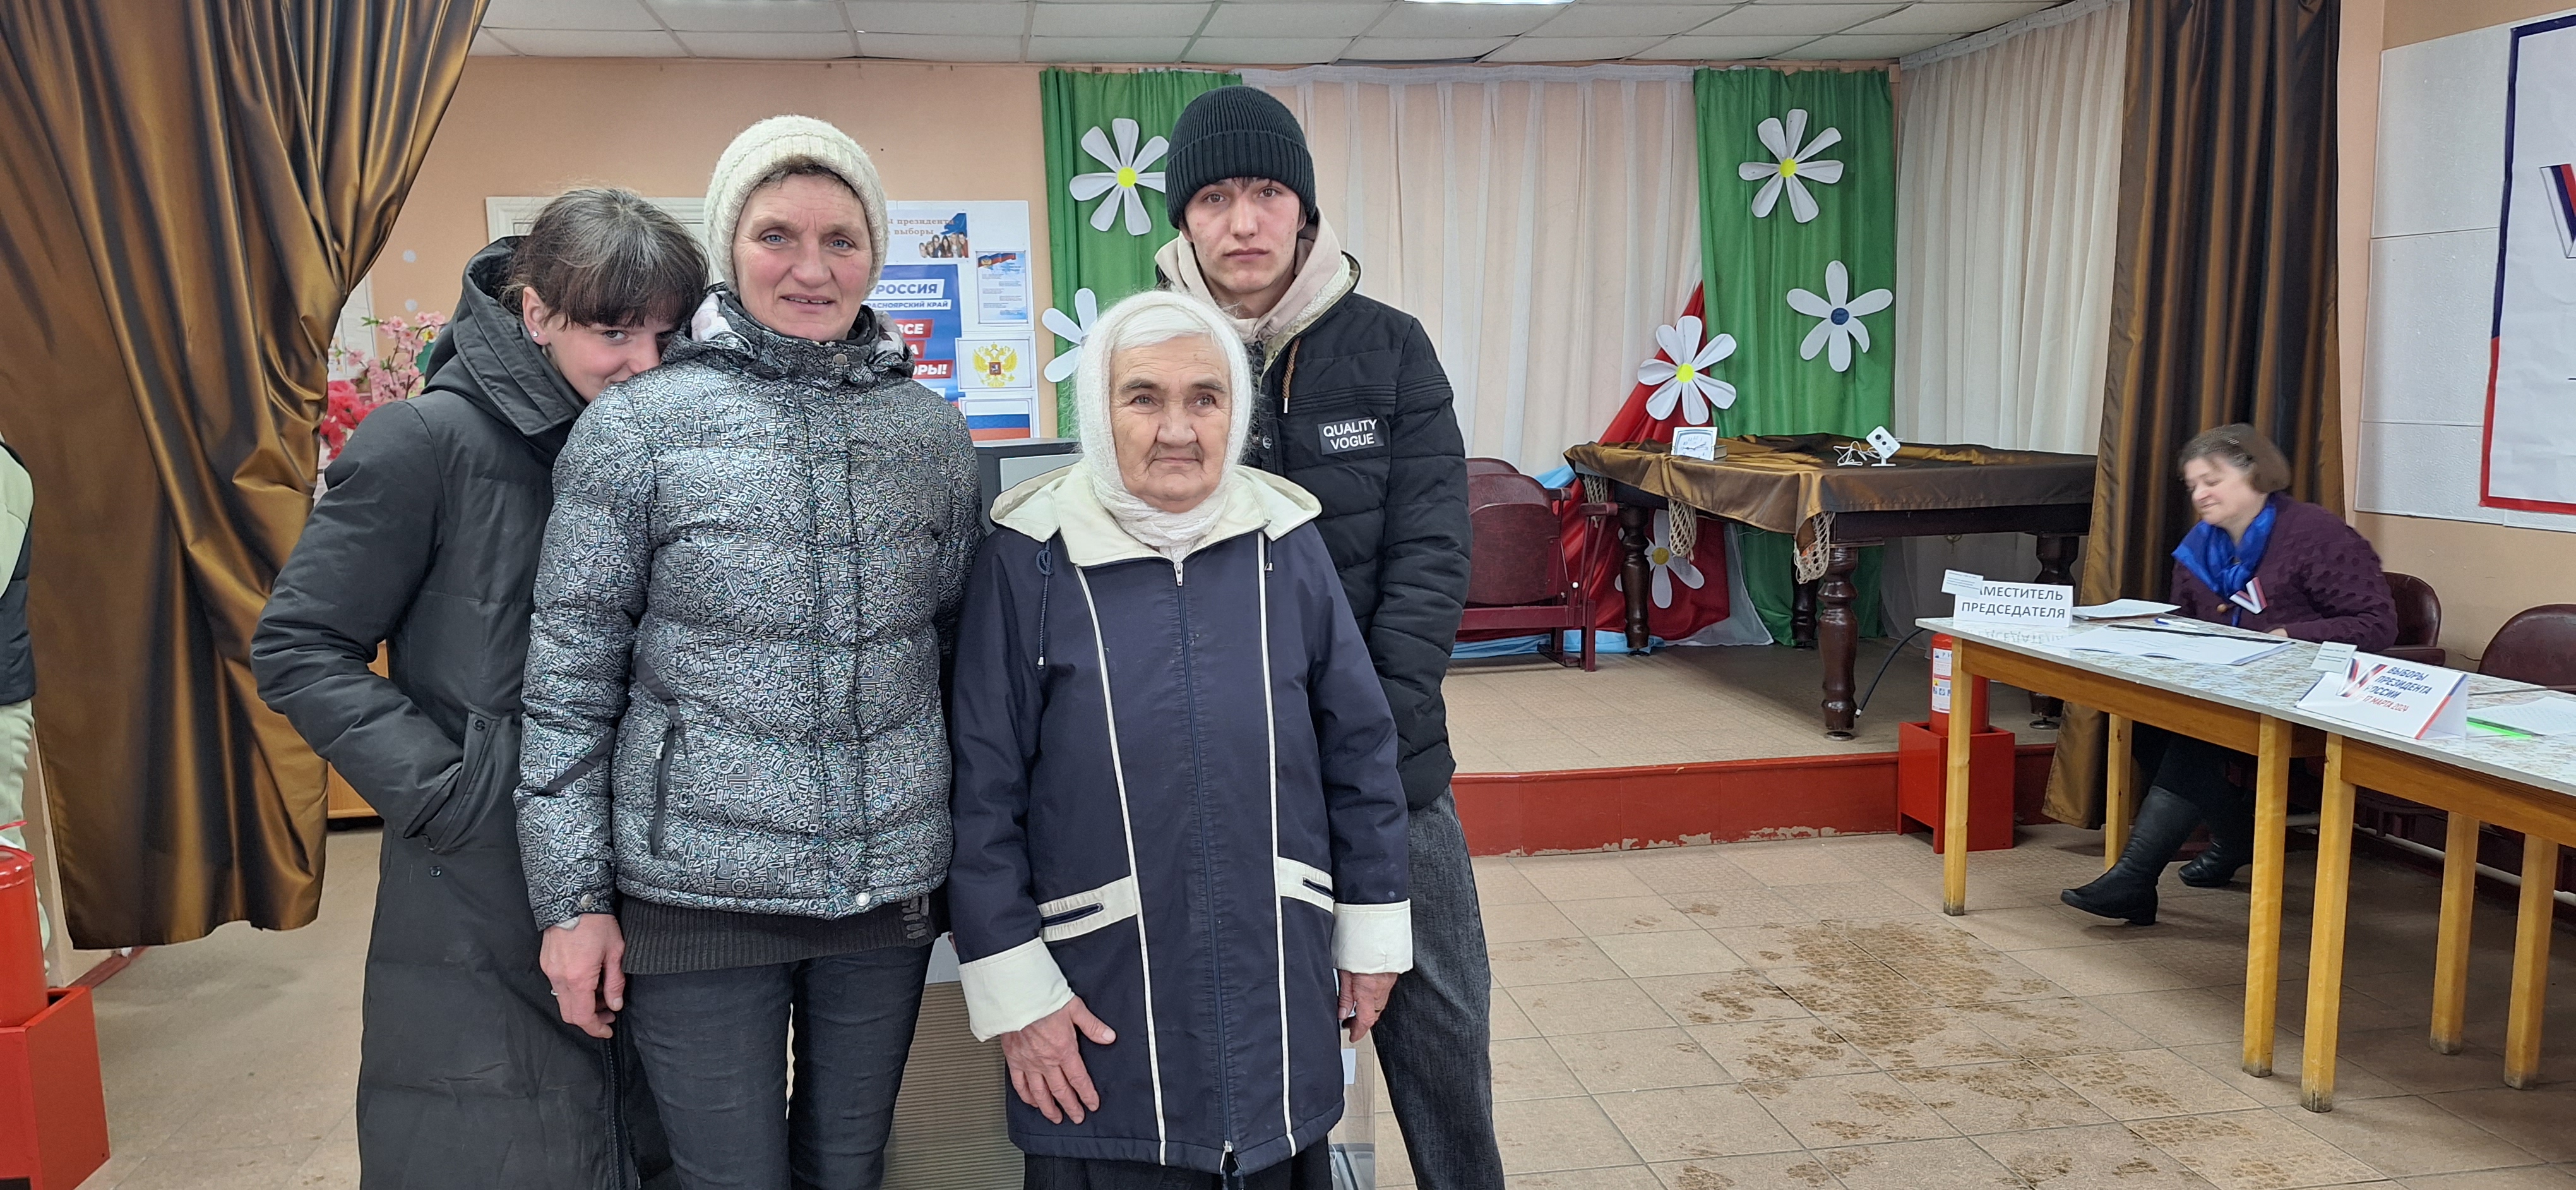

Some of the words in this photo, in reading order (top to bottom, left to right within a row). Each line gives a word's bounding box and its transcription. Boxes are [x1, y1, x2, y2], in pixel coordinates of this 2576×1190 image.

[894, 228, 934, 236] выборы
[875, 284, 938, 294] РОССИЯ
[910, 344, 919, 355] А
[913, 364, 948, 375] РЫ!
[1323, 419, 1378, 437] QUALITY
[1330, 433, 1374, 450] VOGUE
[1980, 586, 2063, 600] МЕСТИТЕЛЬ
[1962, 602, 2065, 618] ПРЕДСЕДАТЕЛЯ
[2387, 666, 2429, 681] ВЫБОРЫ
[2375, 675, 2433, 694] ПРЕЗИДЕНТА
[2370, 696, 2394, 708] МАРТА
